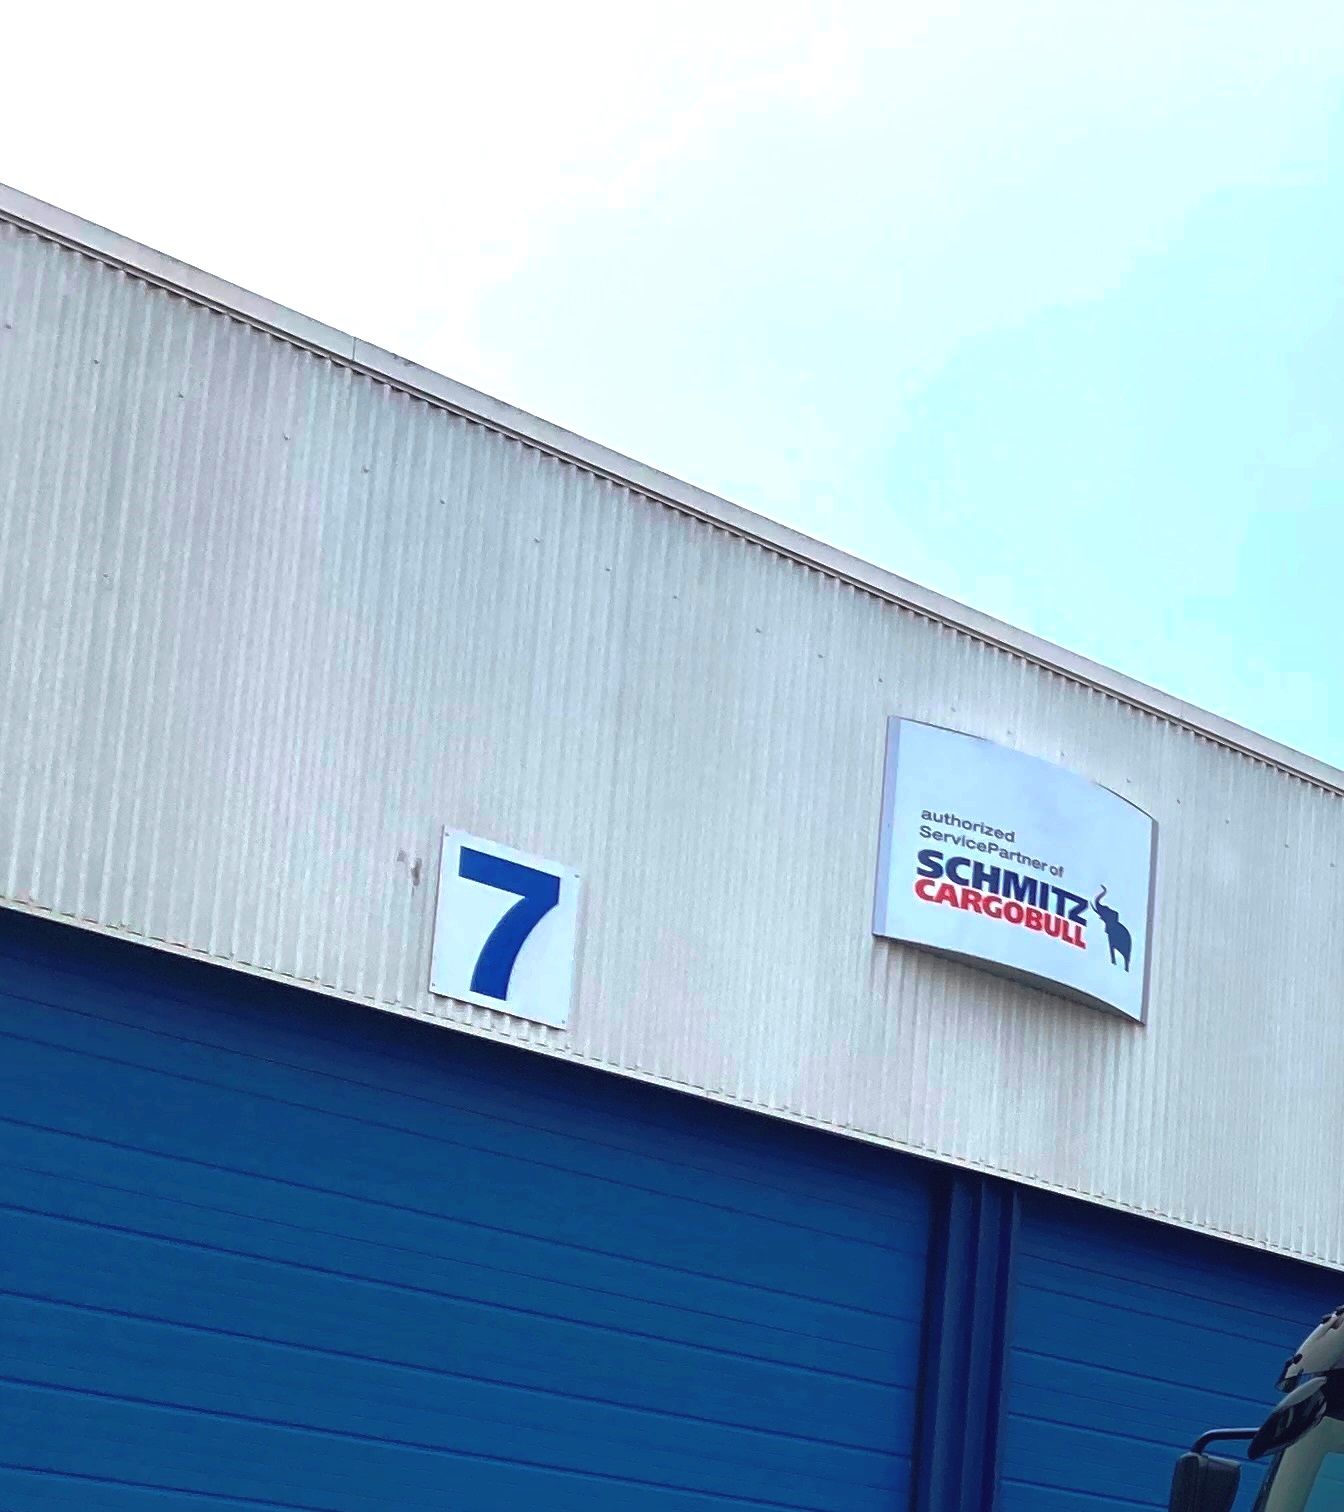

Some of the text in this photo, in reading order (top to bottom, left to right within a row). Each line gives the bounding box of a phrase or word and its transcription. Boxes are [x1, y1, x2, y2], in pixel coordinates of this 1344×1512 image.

[919, 825, 1065, 878] ServicePartner of
[920, 809, 1016, 843] authorized
[458, 844, 562, 1001] 7
[914, 878, 1087, 950] CARGOBULL
[916, 848, 1089, 928] SCHMITZ
